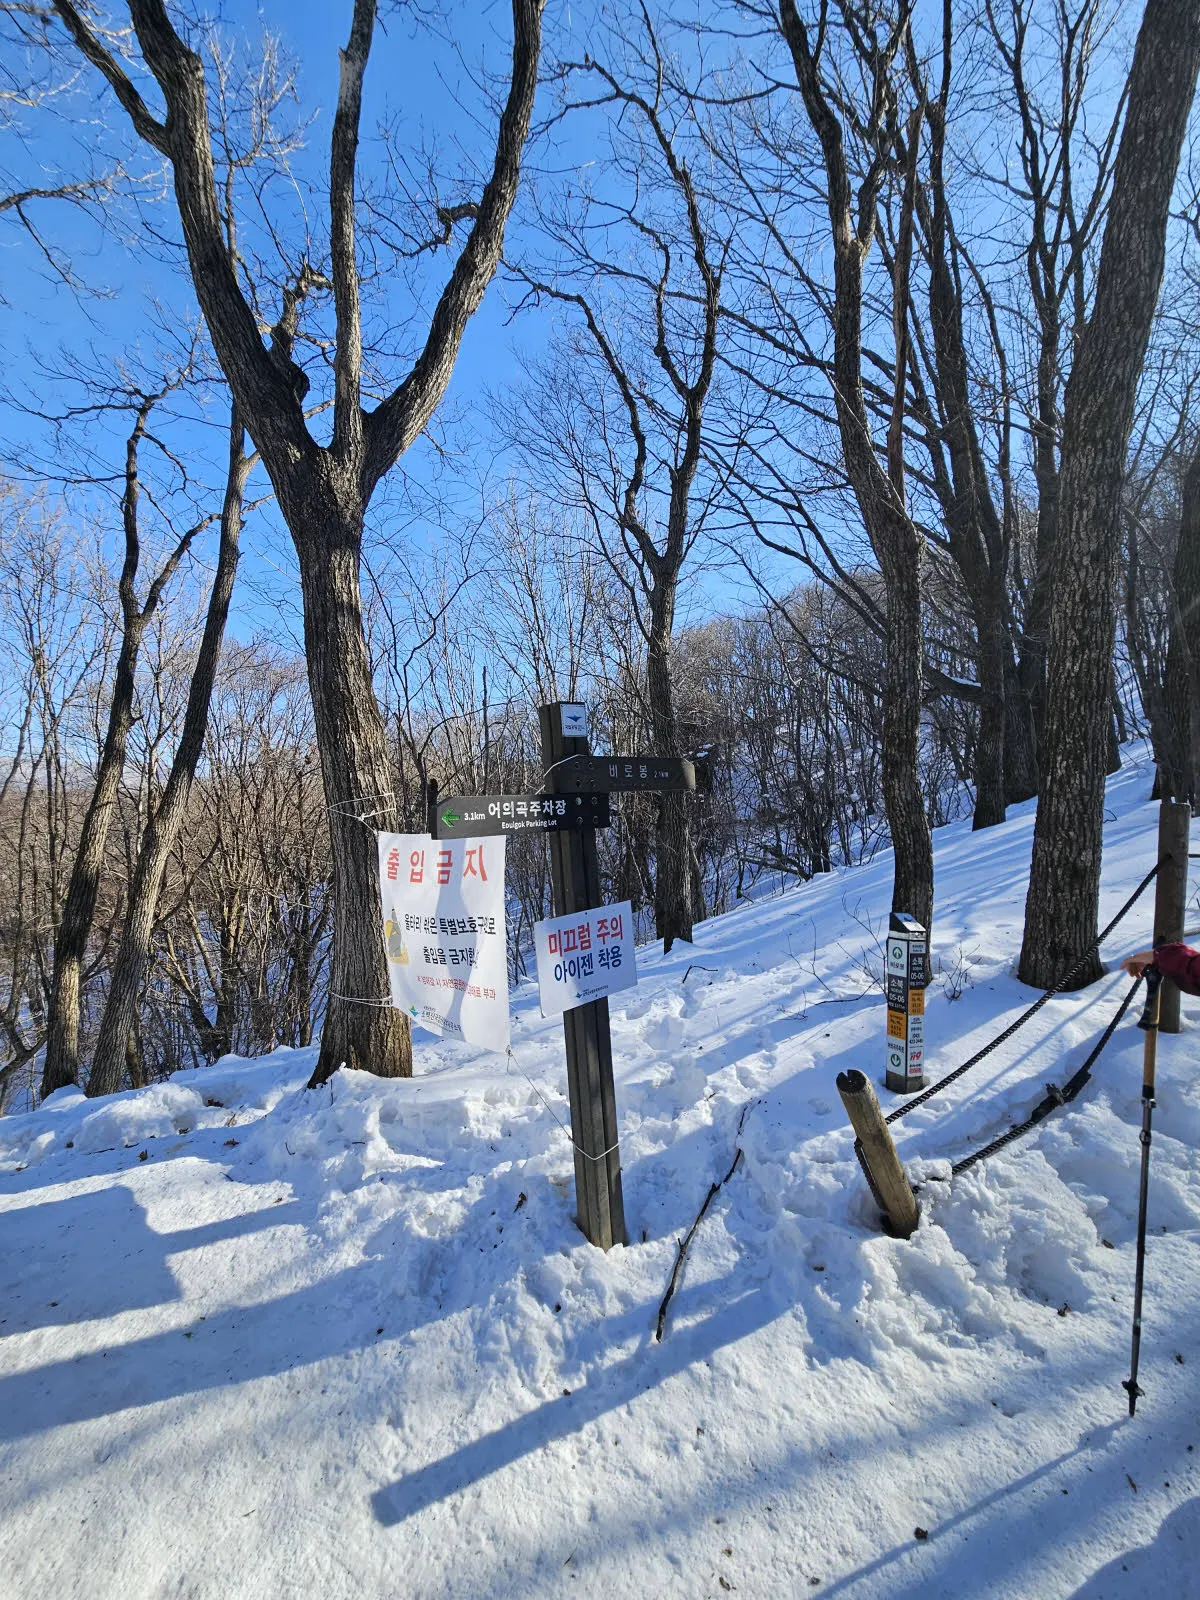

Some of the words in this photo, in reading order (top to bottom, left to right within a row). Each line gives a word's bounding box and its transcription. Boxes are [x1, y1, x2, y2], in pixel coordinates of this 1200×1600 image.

[609, 764, 648, 779] 비로봉
[464, 812, 486, 821] 3.1km
[488, 799, 567, 818] 어의곡주차장
[525, 819, 548, 828] Parking
[404, 913, 421, 934] 울타리
[548, 921, 592, 957] 미끄럼
[597, 914, 624, 945] 주의
[423, 946, 447, 965] 출입을
[554, 952, 595, 983] 아이젠
[598, 945, 623, 970] 착용
[911, 972, 925, 980] 05-06
[483, 987, 496, 1001] 부과
[889, 992, 905, 1003] 05-06
